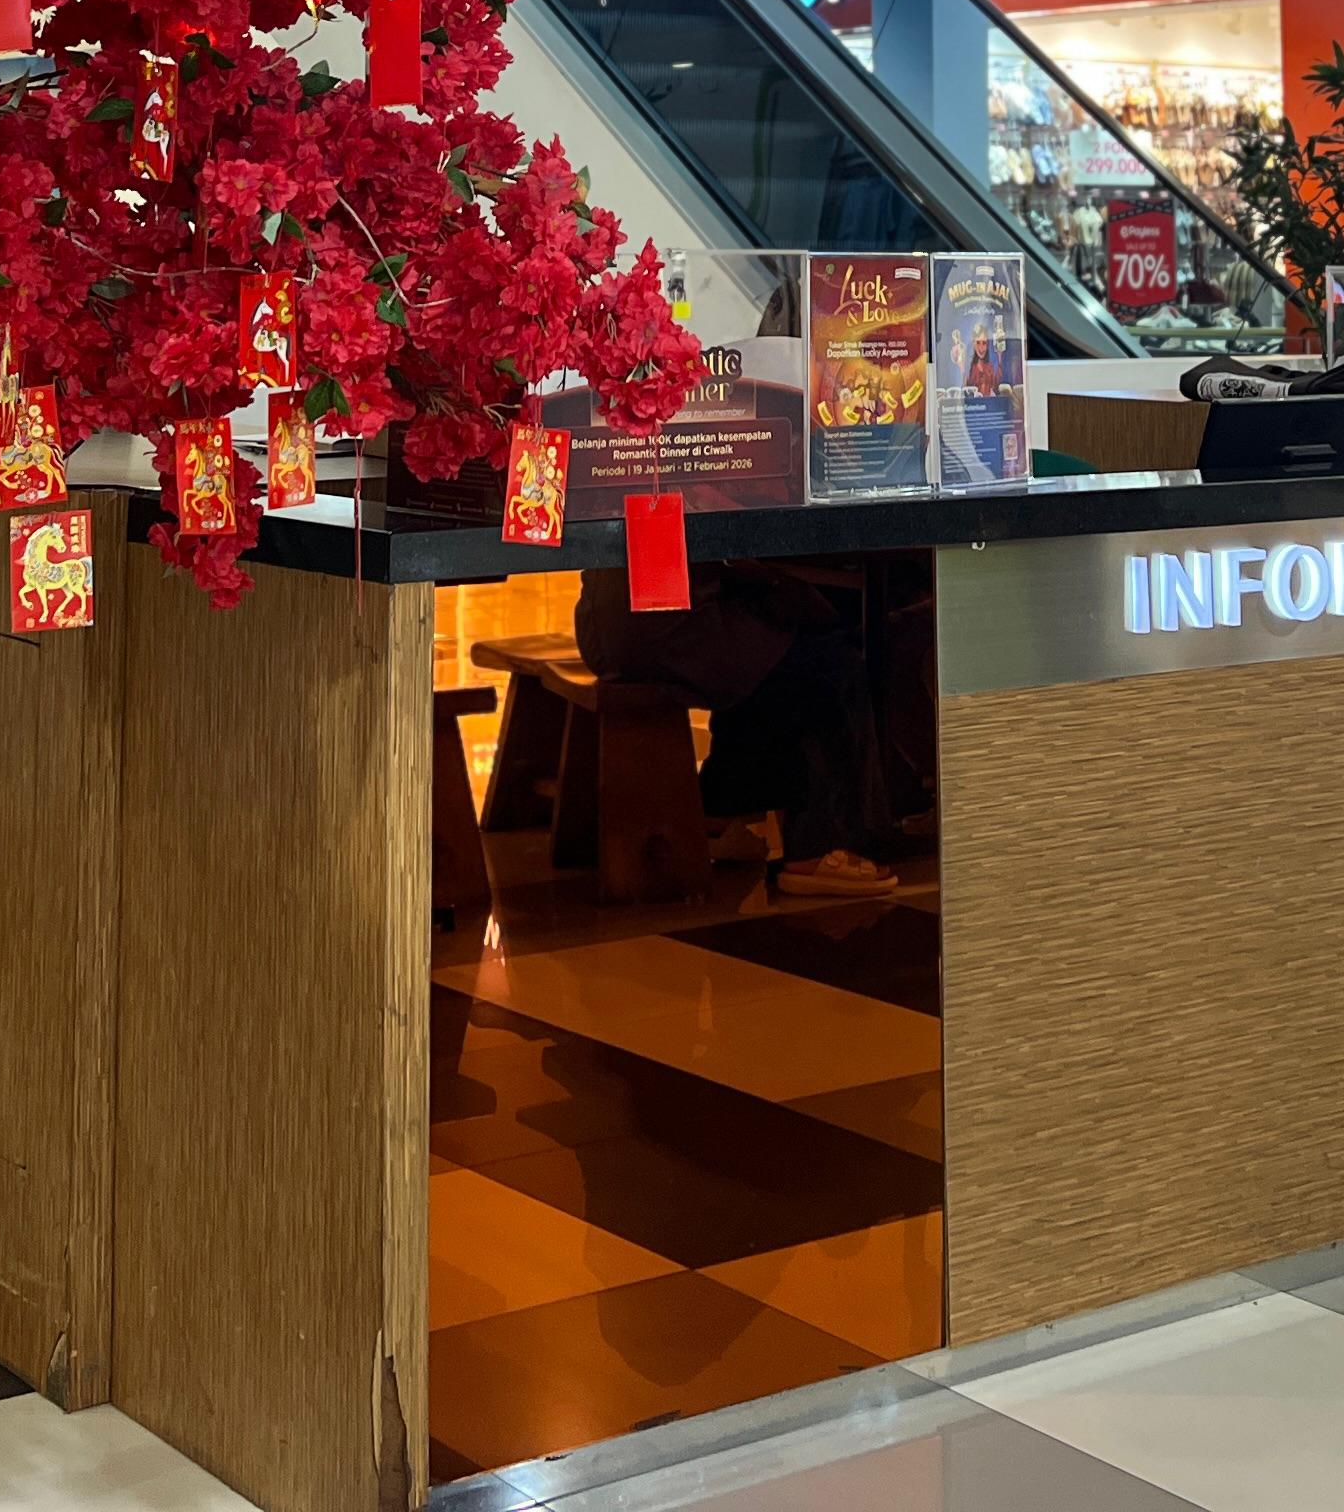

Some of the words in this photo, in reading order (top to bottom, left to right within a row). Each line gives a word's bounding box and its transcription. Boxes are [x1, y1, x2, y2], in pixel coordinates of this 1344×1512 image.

[1113, 254, 1170, 288] 70%
[572, 438, 607, 449] Belanja
[609, 436, 645, 447] minimal
[674, 433, 716, 445] dapatkan
[718, 431, 772, 443] kesempatan
[613, 449, 656, 460] Romantic
[660, 447, 690, 458] Dinner
[692, 445, 702, 456] di
[703, 444, 733, 455] Ciwalk
[592, 466, 626, 477] Periode
[633, 464, 642, 475] 19
[684, 461, 692, 472] 12
[694, 459, 729, 471] Februari
[731, 458, 752, 469] 2026
